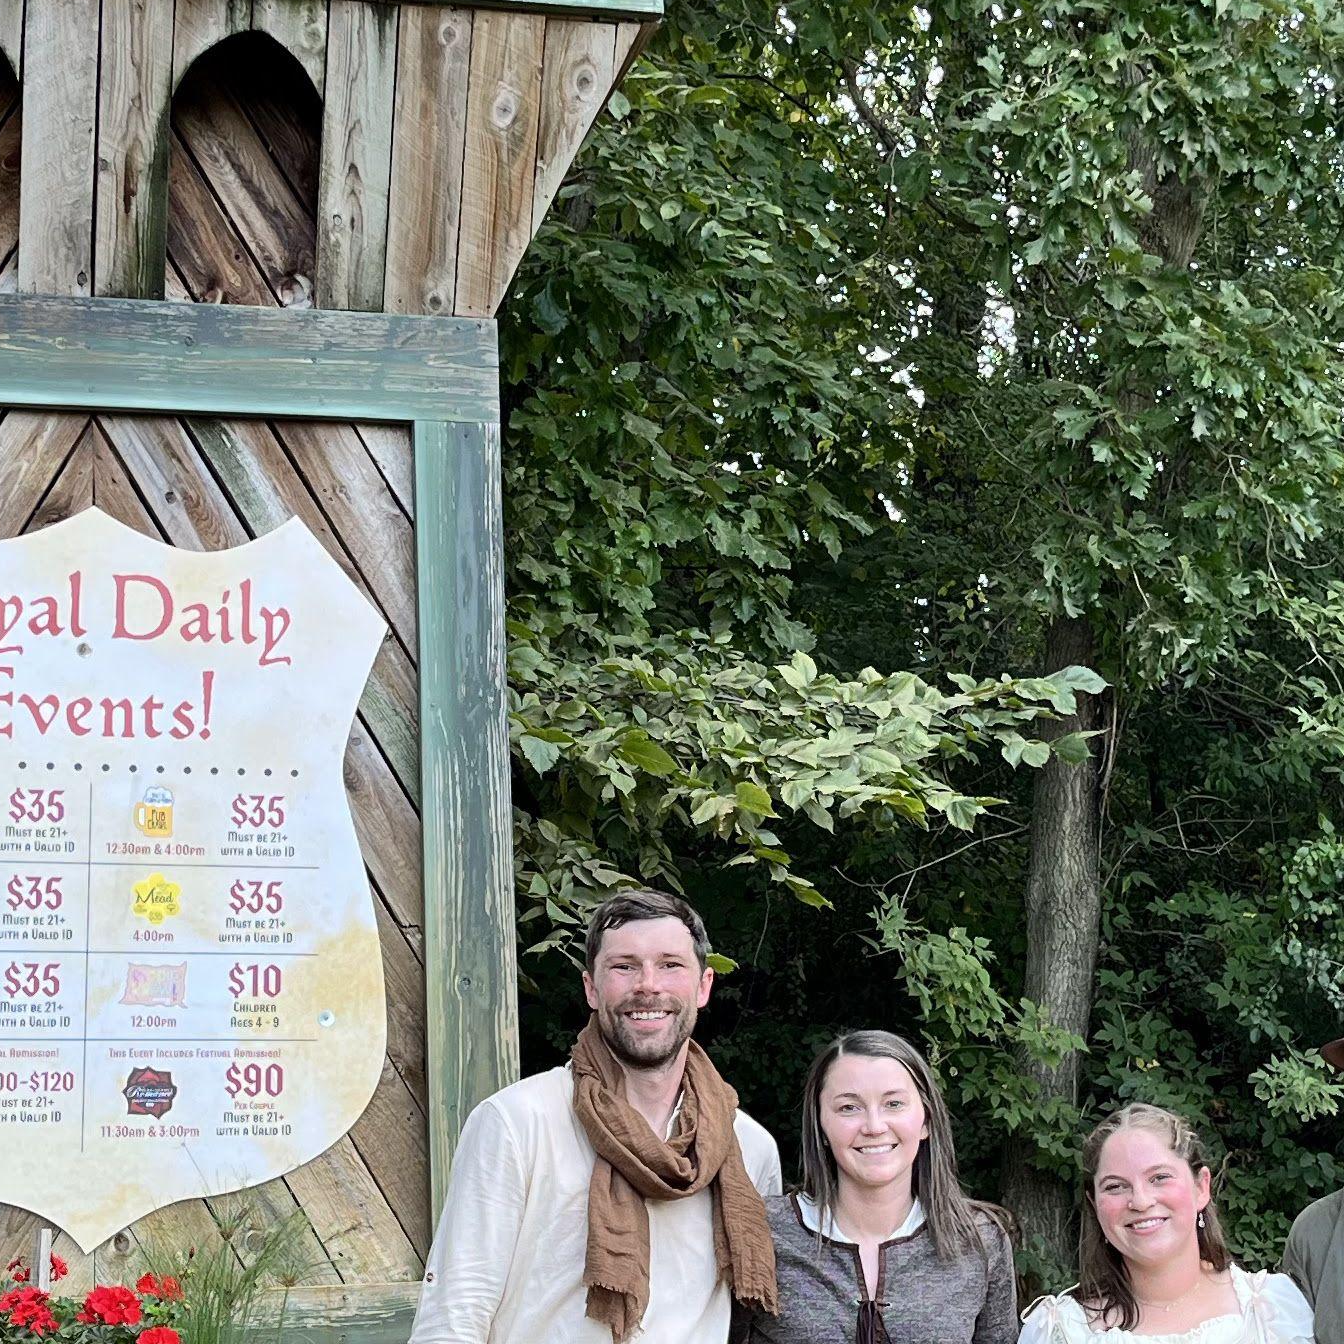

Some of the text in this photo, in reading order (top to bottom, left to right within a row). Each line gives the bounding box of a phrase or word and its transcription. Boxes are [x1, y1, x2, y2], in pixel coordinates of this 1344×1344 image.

[112, 574, 291, 666] Daily
[9, 787, 65, 823] $35
[231, 794, 284, 829] $35
[50, 827, 68, 838] 21+
[270, 832, 288, 842] 21+
[154, 844, 161, 855] &
[6, 874, 62, 911] $35
[136, 887, 173, 904] Mead
[229, 879, 283, 915] $35
[47, 915, 65, 925] 21+
[269, 918, 285, 929] 21+
[3, 961, 61, 998] $35
[228, 962, 281, 998] $10
[45, 1002, 64, 1012] 21+
[256, 1017, 262, 1027] 4
[273, 1017, 279, 1028] 9
[225, 1062, 283, 1099] $90
[36, 1096, 55, 1107] 21+
[267, 1111, 284, 1122] 21+
[148, 1126, 156, 1137] &
